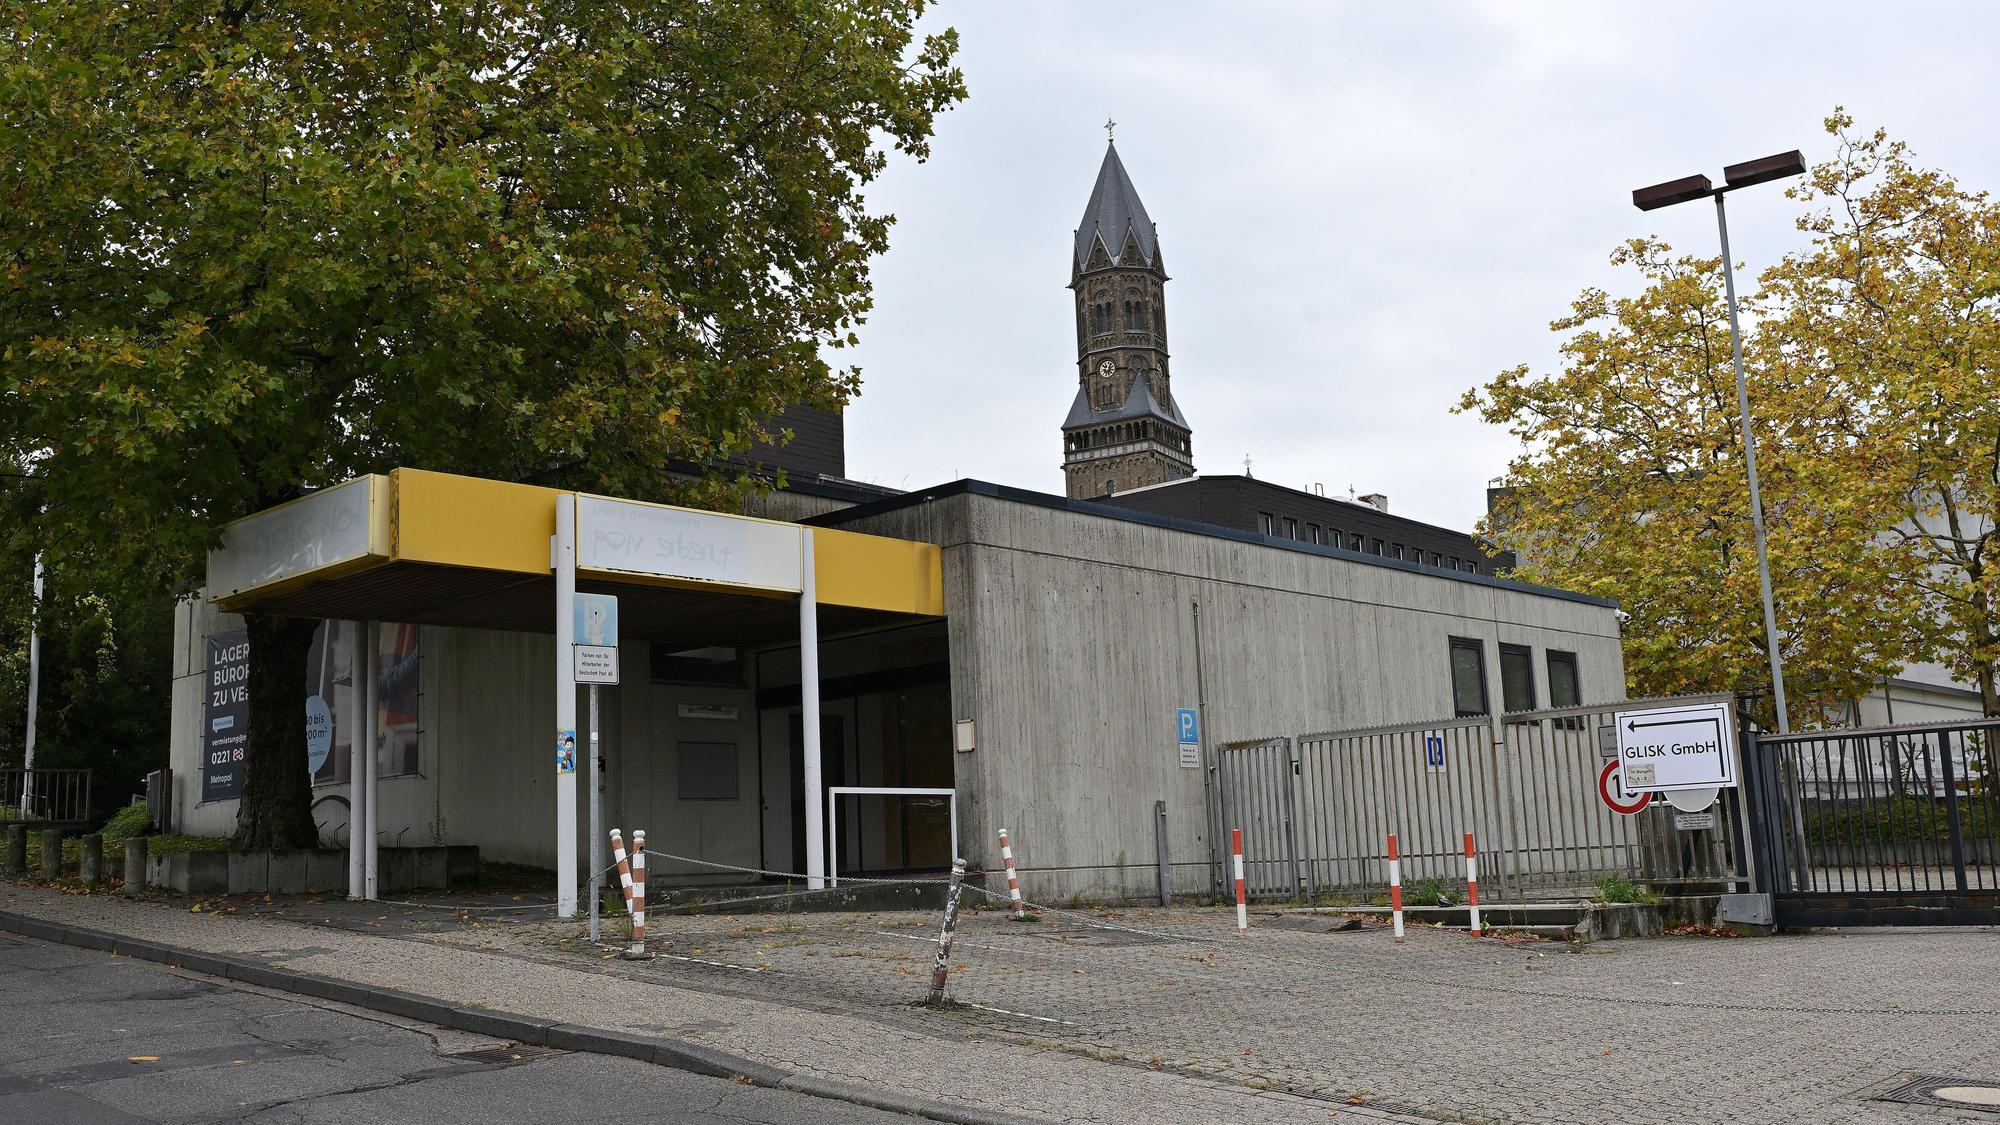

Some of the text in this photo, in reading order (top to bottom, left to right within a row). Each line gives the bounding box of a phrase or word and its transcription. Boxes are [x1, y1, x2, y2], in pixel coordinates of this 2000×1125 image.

[213, 690, 228, 707] ZU
[313, 713, 325, 724] bis
[1181, 713, 1193, 739] P
[211, 749, 230, 765] 0221
[1625, 740, 1717, 759] GLISK GmbH
[210, 772, 232, 784] Metropol
[1612, 774, 1638, 799] 1
